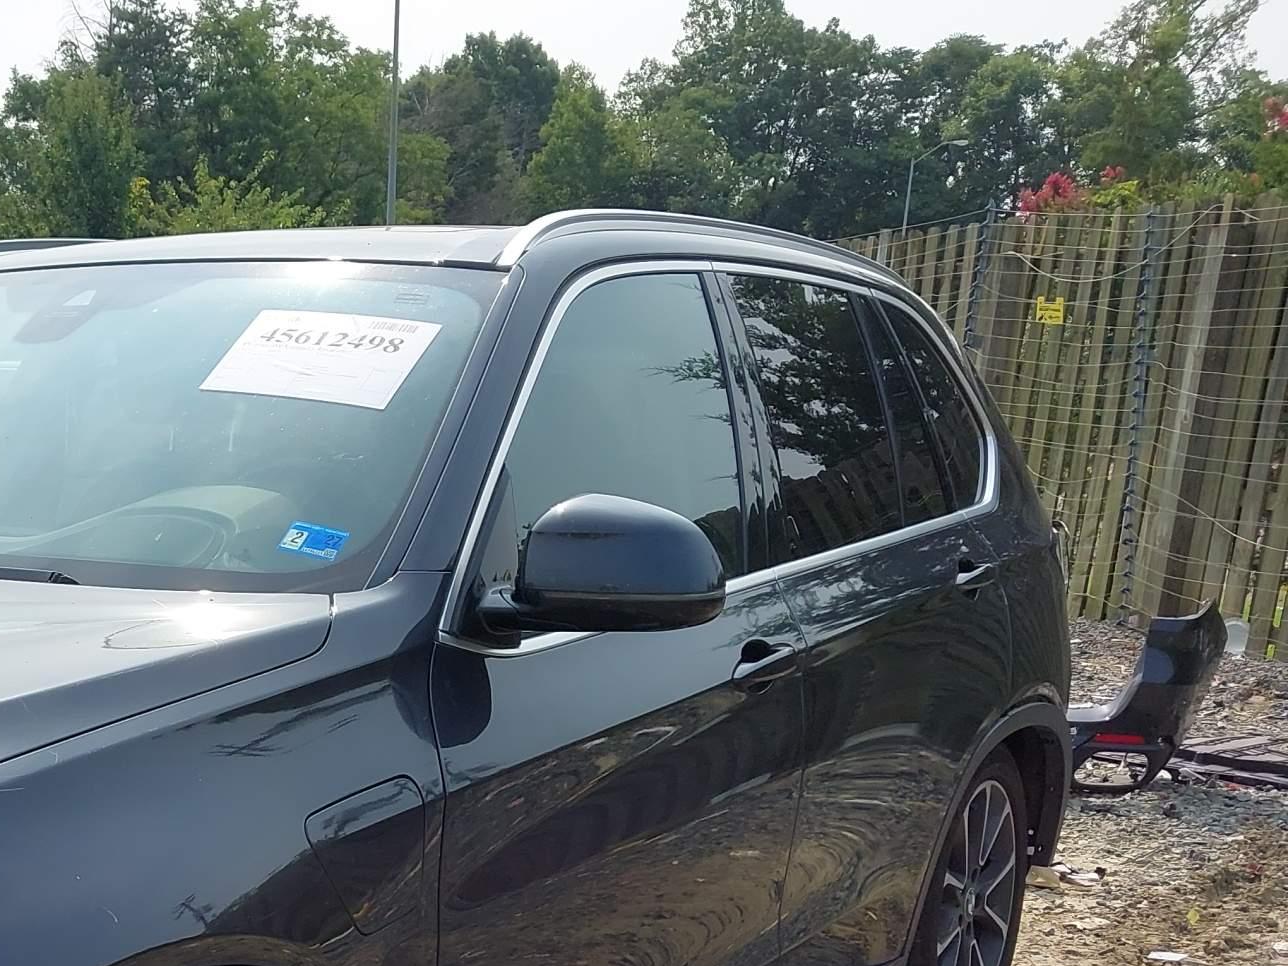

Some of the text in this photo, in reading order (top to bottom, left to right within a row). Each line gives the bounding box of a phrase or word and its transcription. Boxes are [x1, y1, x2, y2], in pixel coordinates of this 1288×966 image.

[259, 327, 405, 354] 45612498
[290, 531, 304, 544] 2
[323, 534, 344, 547] 27
